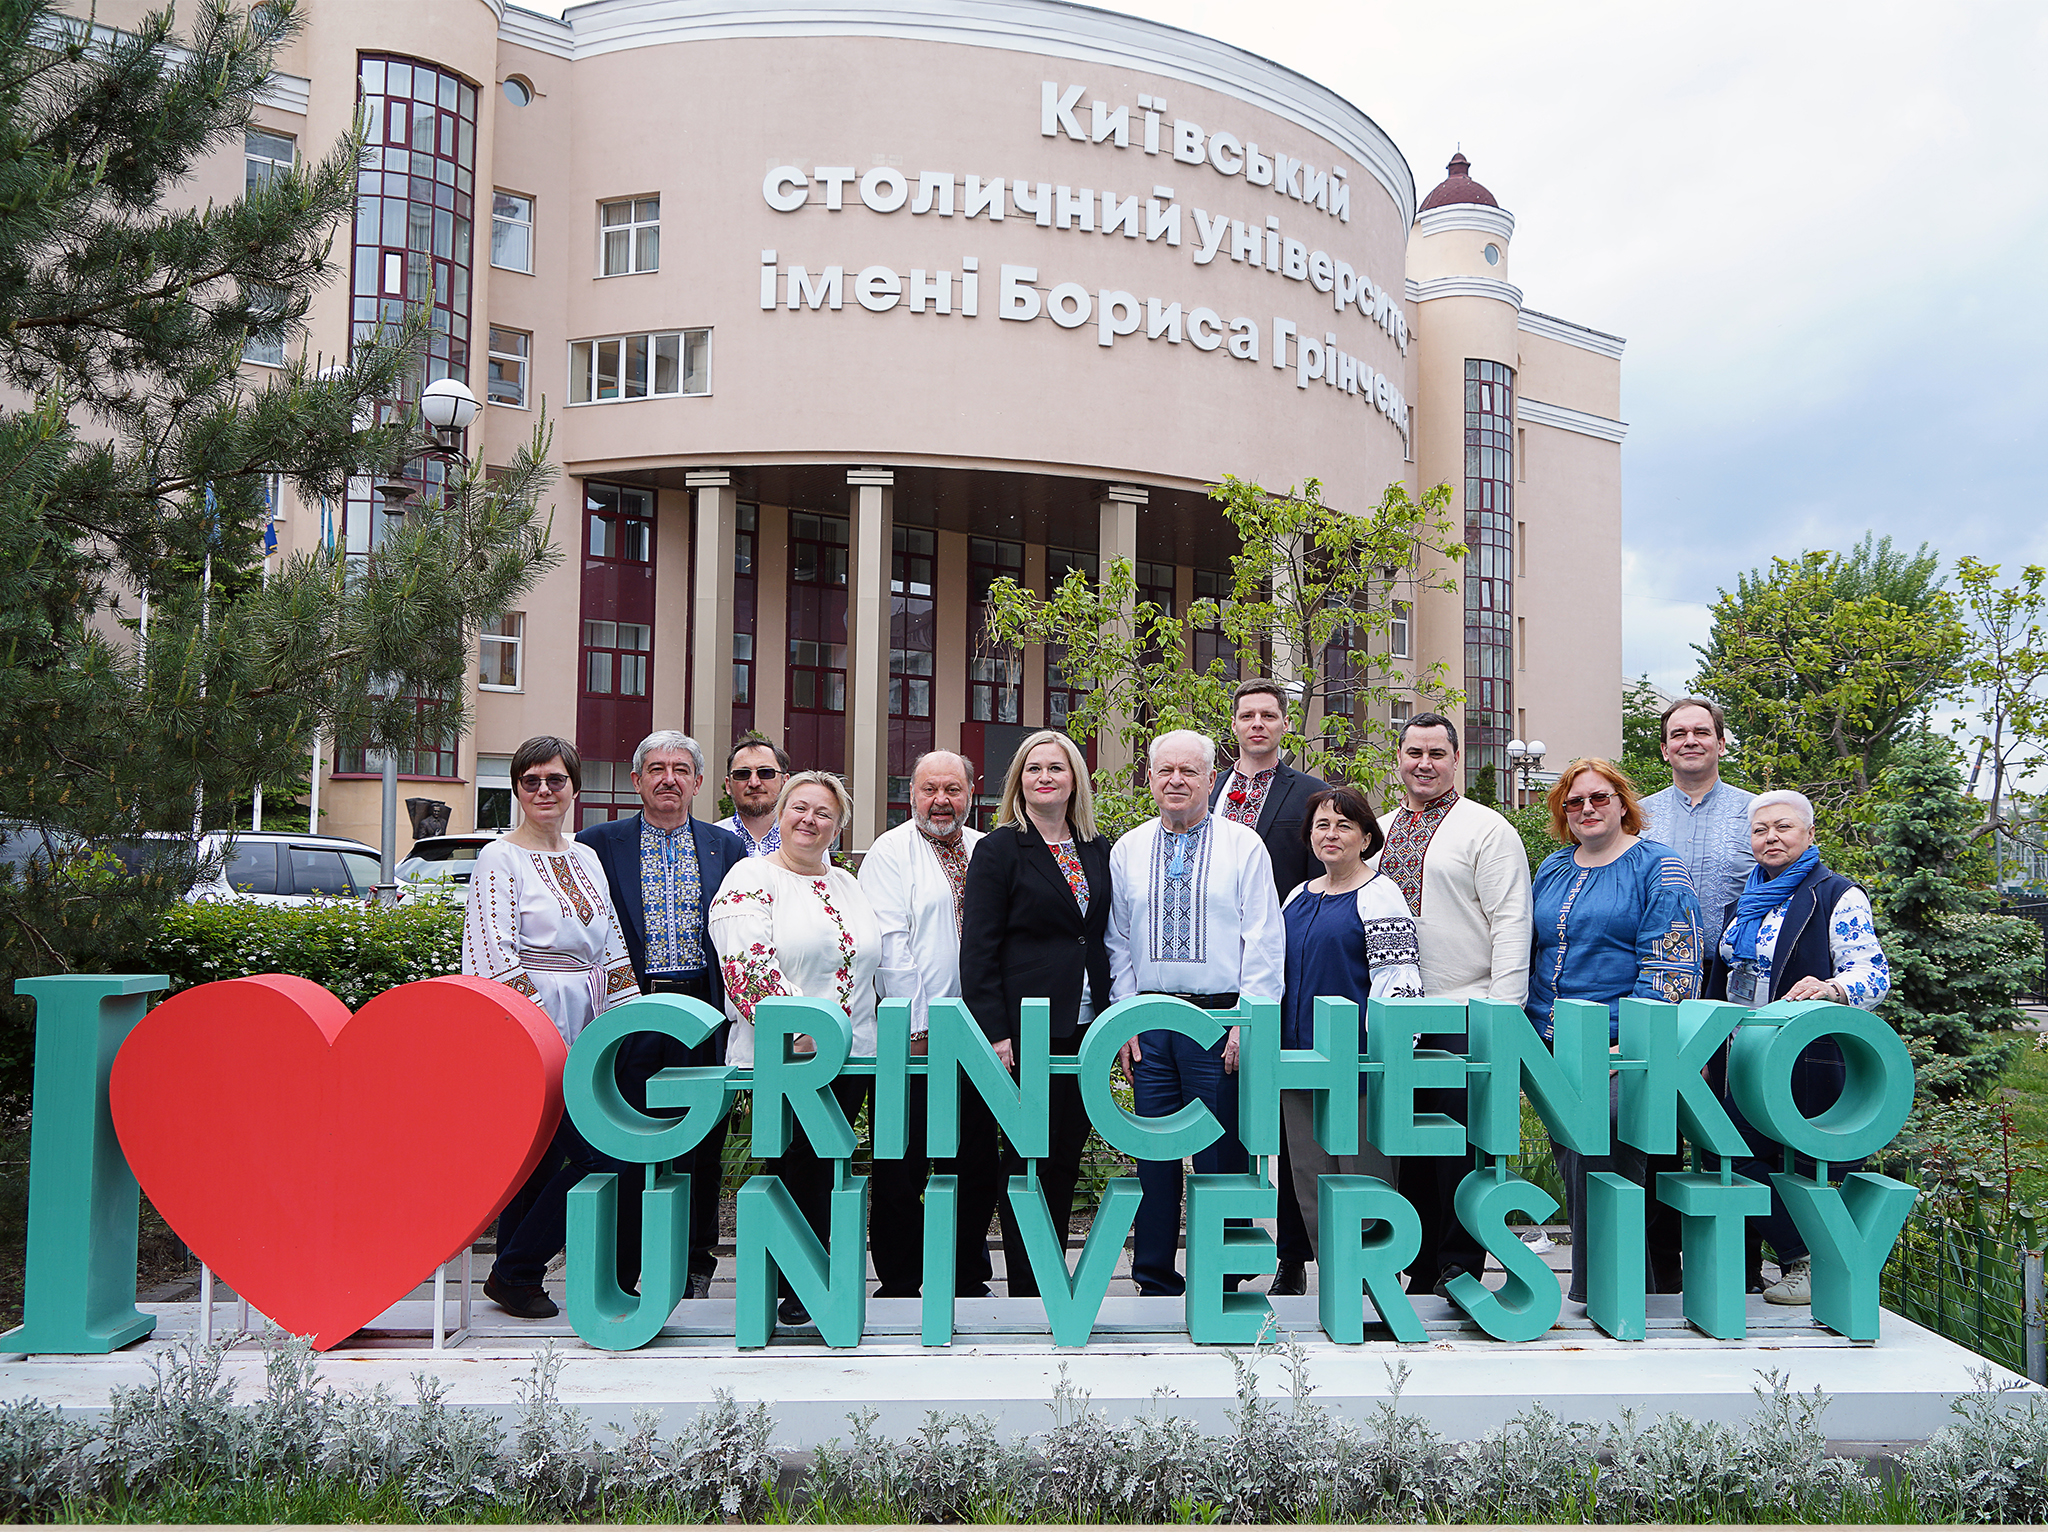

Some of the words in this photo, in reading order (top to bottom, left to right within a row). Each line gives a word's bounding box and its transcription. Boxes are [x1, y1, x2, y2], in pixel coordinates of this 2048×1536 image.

[1041, 80, 1350, 223] Київський
[760, 249, 979, 317] імені
[999, 263, 1260, 362] Бориса
[1273, 316, 1410, 443] Грінчен
[762, 164, 1182, 246] столичний
[1193, 207, 1407, 358] університе
[0, 974, 171, 1354] I
[563, 992, 1915, 1163] GRINCHENKO
[565, 1171, 1920, 1352] UNIVERSITY
